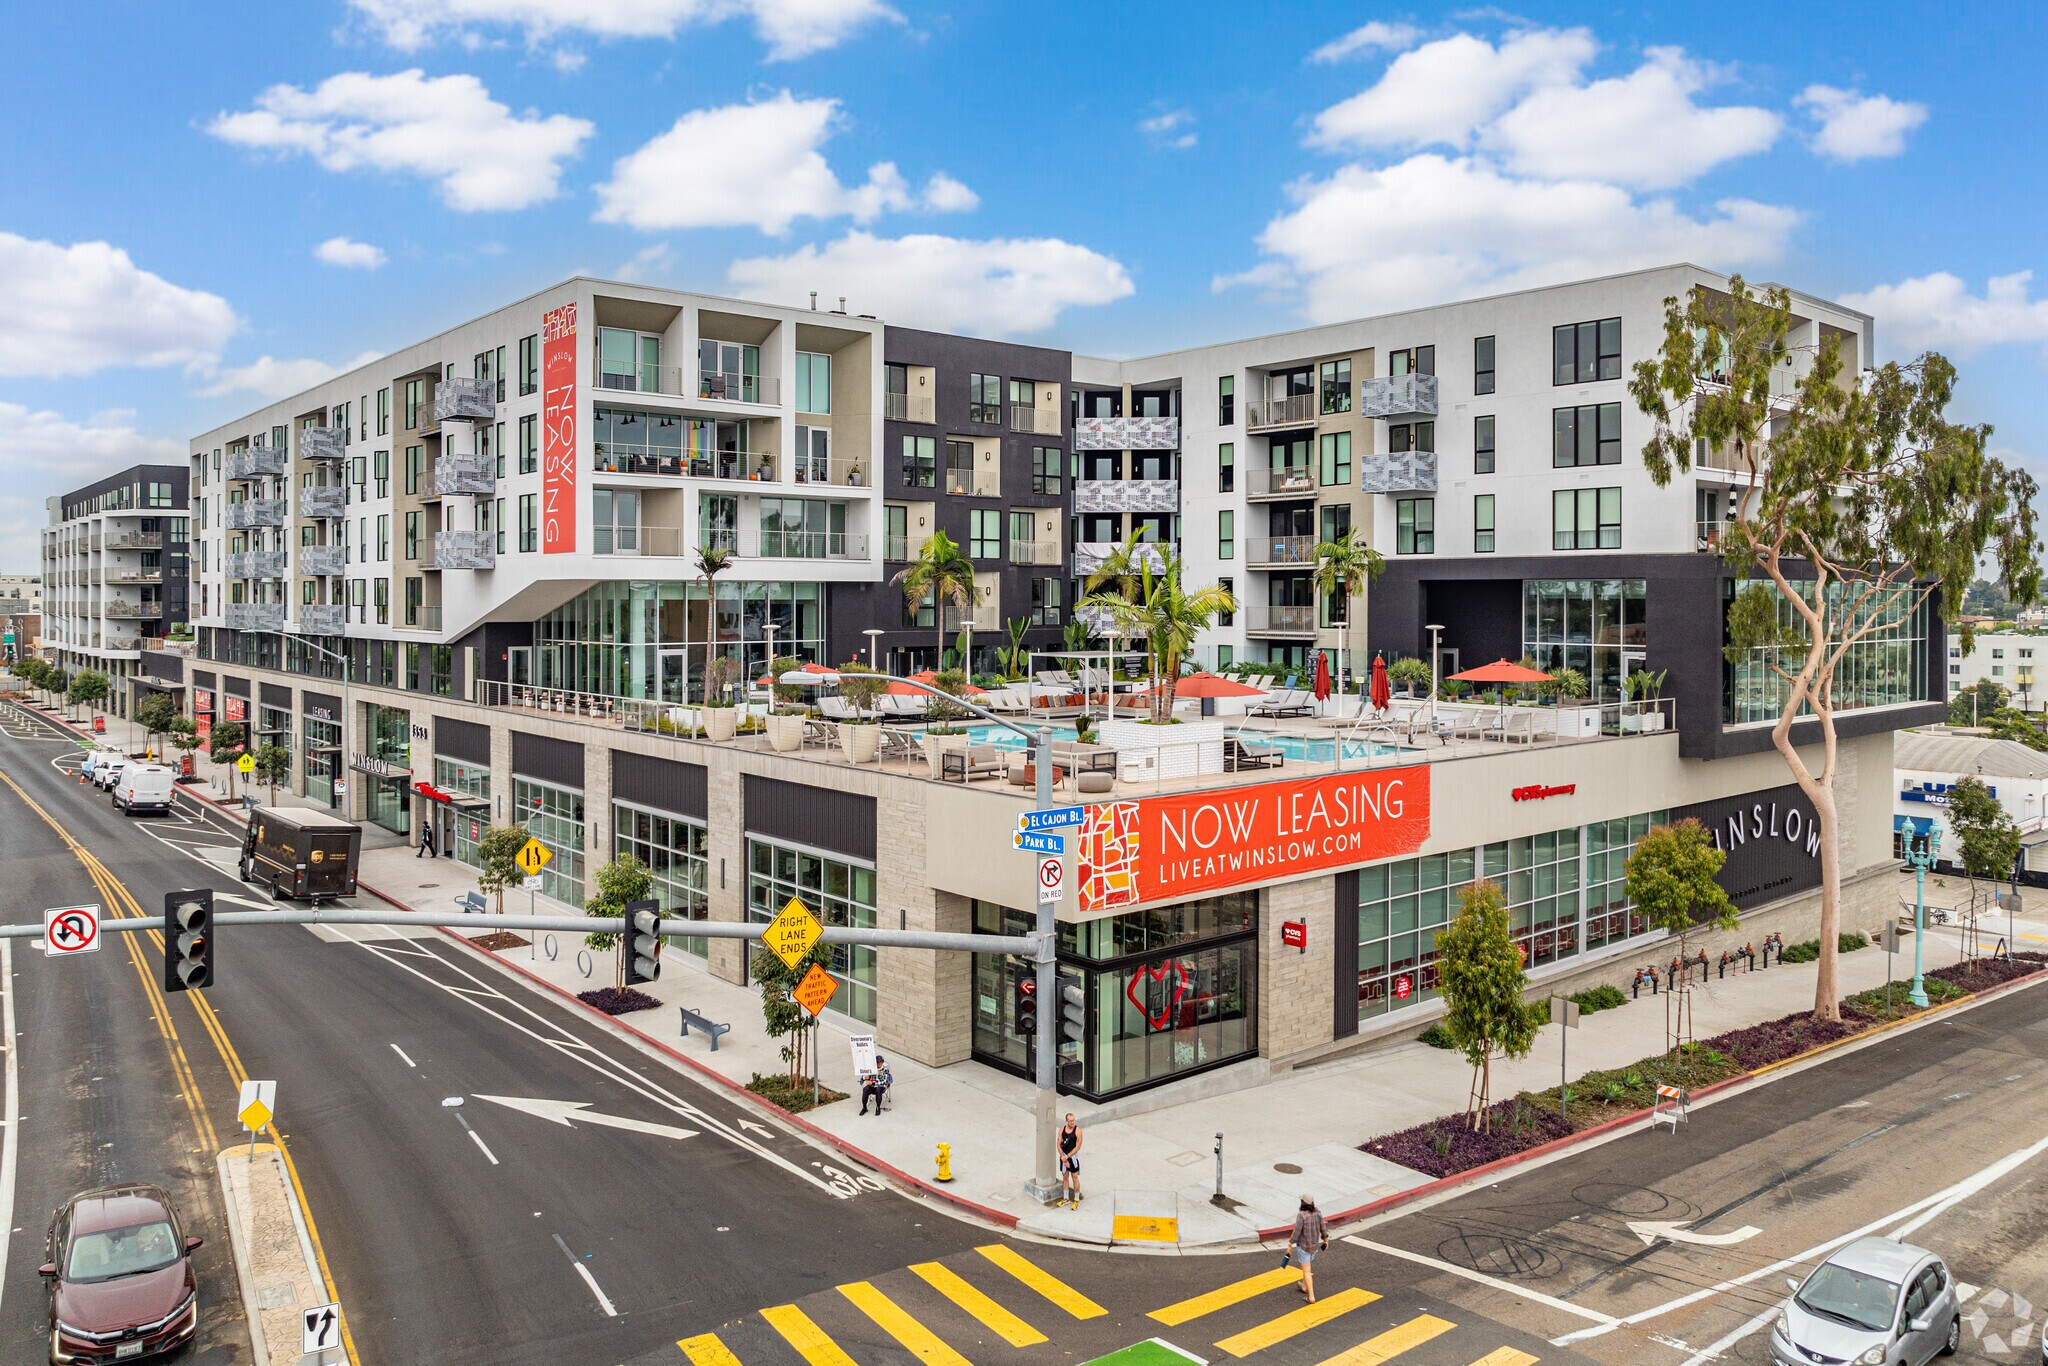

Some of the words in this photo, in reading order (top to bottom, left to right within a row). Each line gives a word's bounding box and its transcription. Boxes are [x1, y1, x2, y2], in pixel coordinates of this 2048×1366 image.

[547, 351, 573, 370] WINSLOW
[560, 384, 574, 486] NOW
[546, 388, 559, 543] LEASING
[312, 706, 332, 720] LEASING
[352, 752, 389, 776] WINSLOW
[1031, 815, 1040, 828] EL
[1042, 813, 1067, 826] CAJON
[1069, 810, 1083, 823] BL.
[1161, 798, 1259, 855] NOW
[1277, 779, 1404, 837] LEASING
[1025, 835, 1045, 849] PARK
[1047, 837, 1061, 851] BL.
[1160, 831, 1362, 884] LIVEATWINSLOW.COM
[1041, 891, 1049, 900] ON
[1051, 889, 1062, 898] RED
[780, 915, 809, 928] RIGHT
[780, 929, 807, 941] LANE
[1290, 929, 1301, 937] CVS
[780, 942, 807, 954] ENDS
[809, 972, 822, 981] NEW
[805, 980, 827, 990] TRAFFIC
[804, 988, 828, 999] PATTERN
[807, 997, 825, 1008] AHEAD
